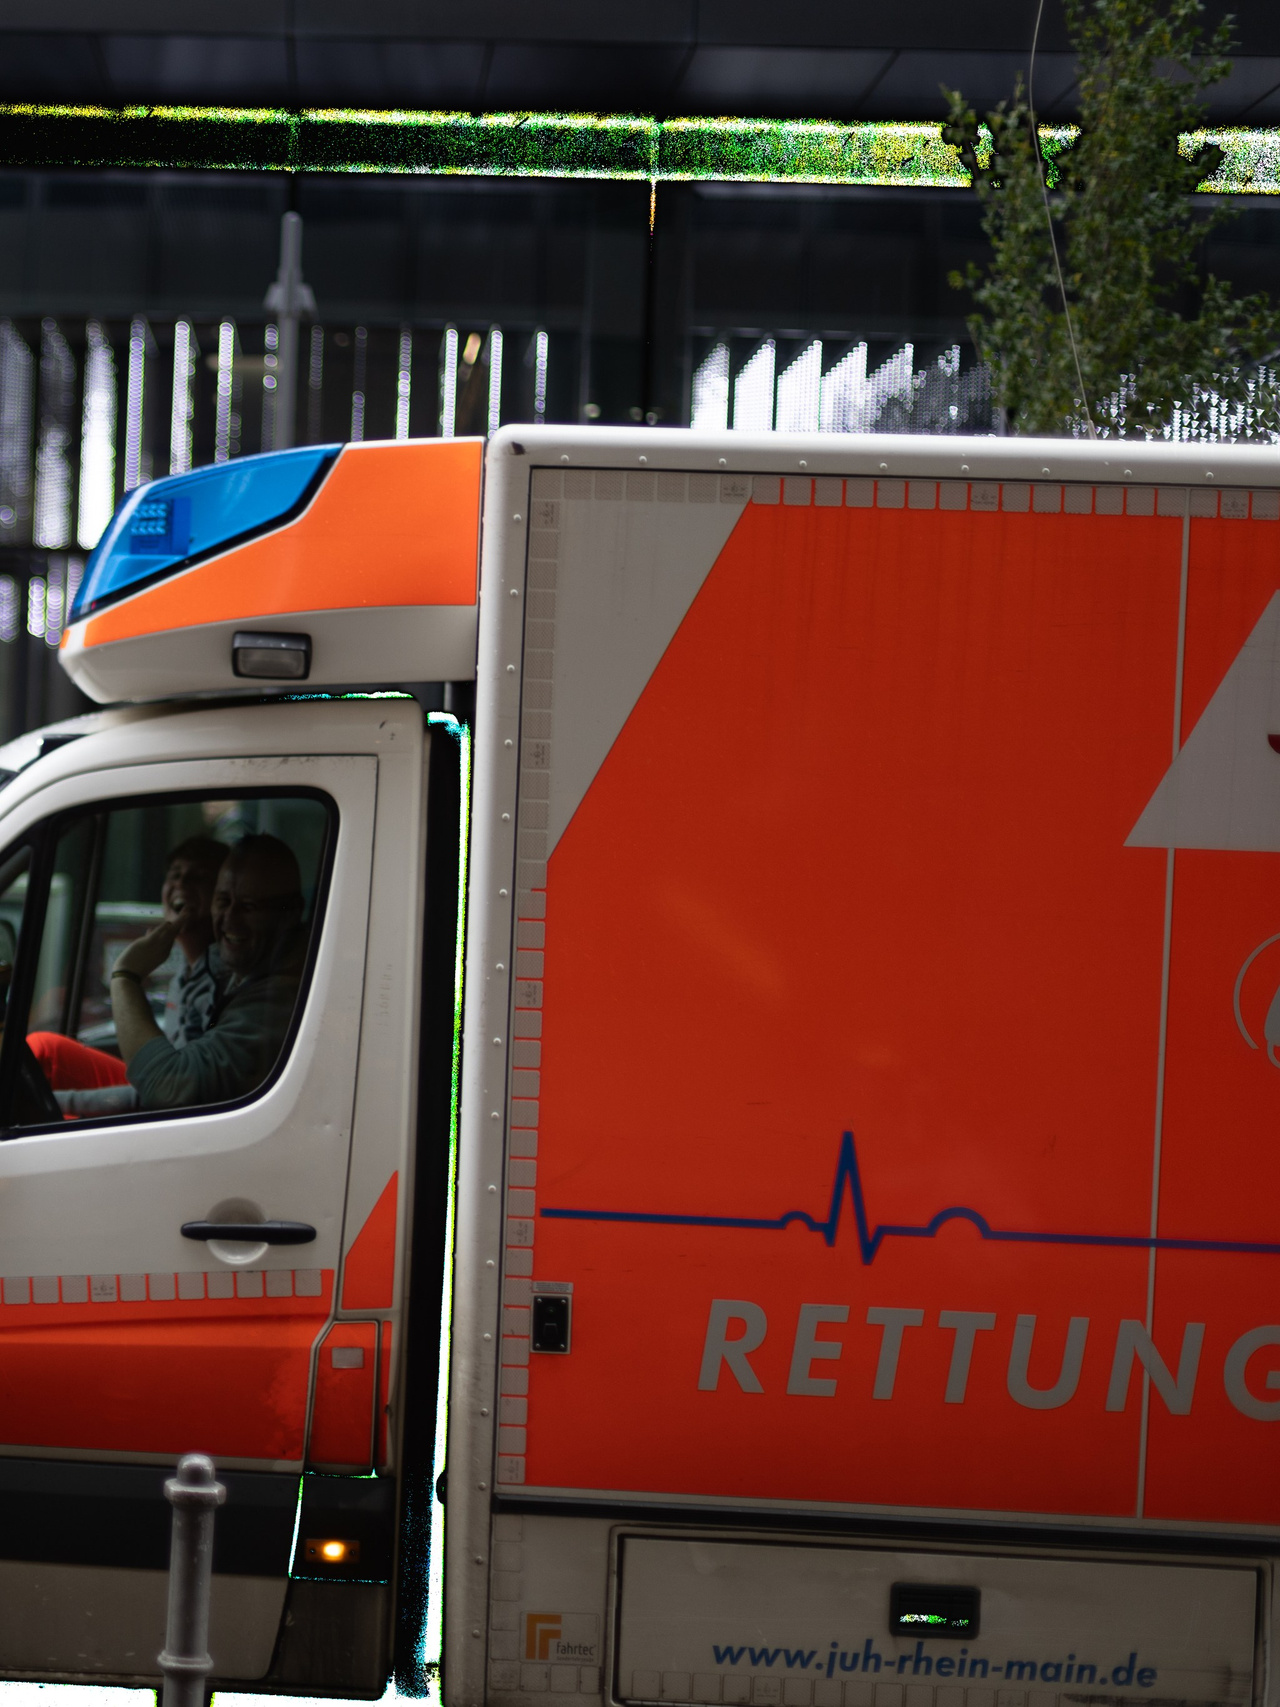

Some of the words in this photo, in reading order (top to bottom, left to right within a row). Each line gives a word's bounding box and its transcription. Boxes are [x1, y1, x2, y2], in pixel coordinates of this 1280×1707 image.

[698, 1299, 1280, 1422] RETTUNG
[556, 1641, 596, 1656] fahrtec
[712, 1638, 1158, 1688] www.juh-rhein-main.de
